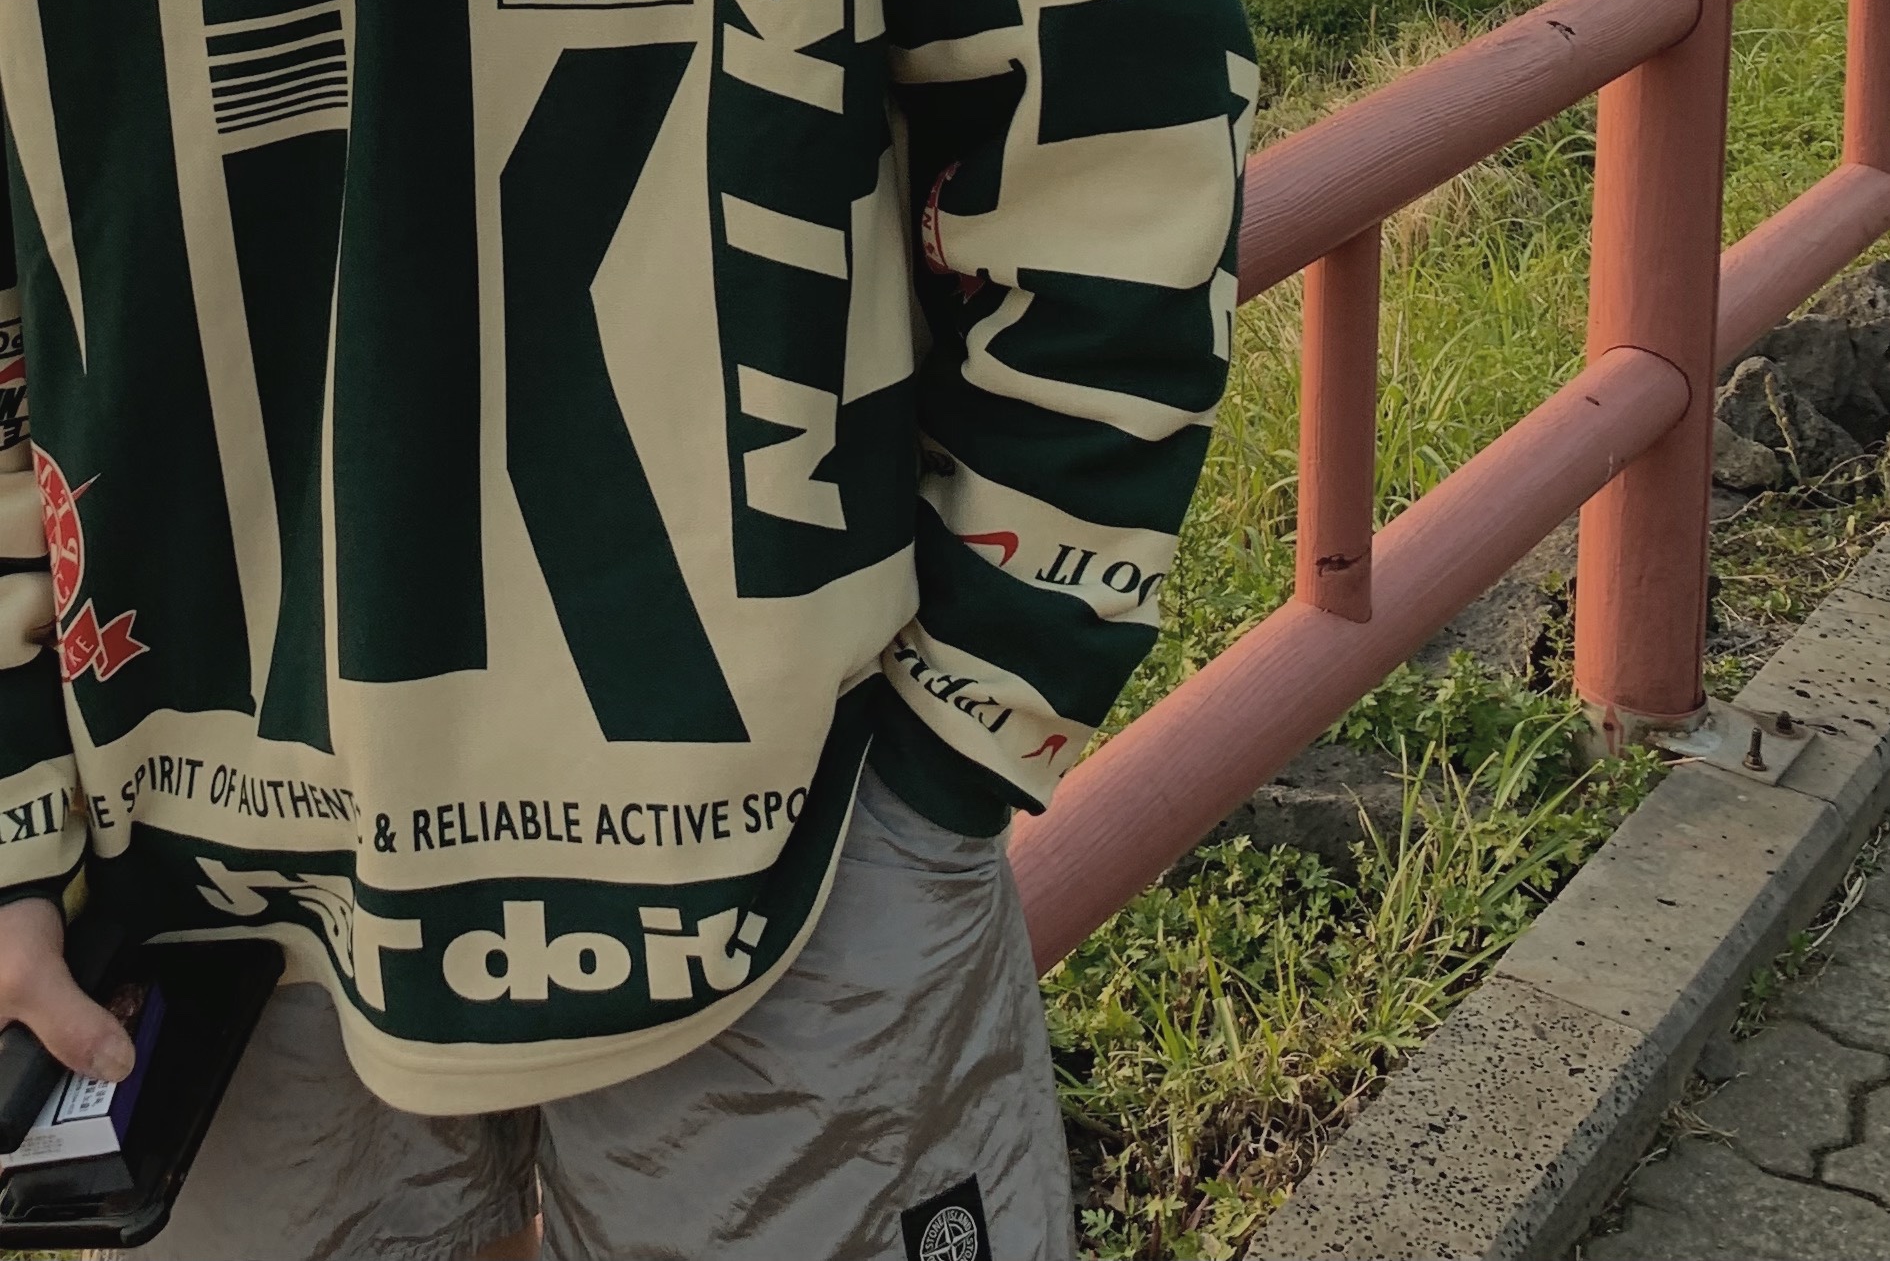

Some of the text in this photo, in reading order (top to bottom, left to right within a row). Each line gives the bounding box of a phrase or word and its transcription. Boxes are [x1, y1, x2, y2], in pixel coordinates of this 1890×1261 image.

[1035, 544, 1097, 586] IT
[121, 755, 203, 814] SPIRIT
[210, 764, 236, 805] OF
[238, 774, 363, 844] AUTHENT
[374, 812, 398, 853] &
[413, 800, 582, 852] RELIABLE
[596, 799, 731, 847] ACTIVE
[925, 1215, 945, 1250] STONE
